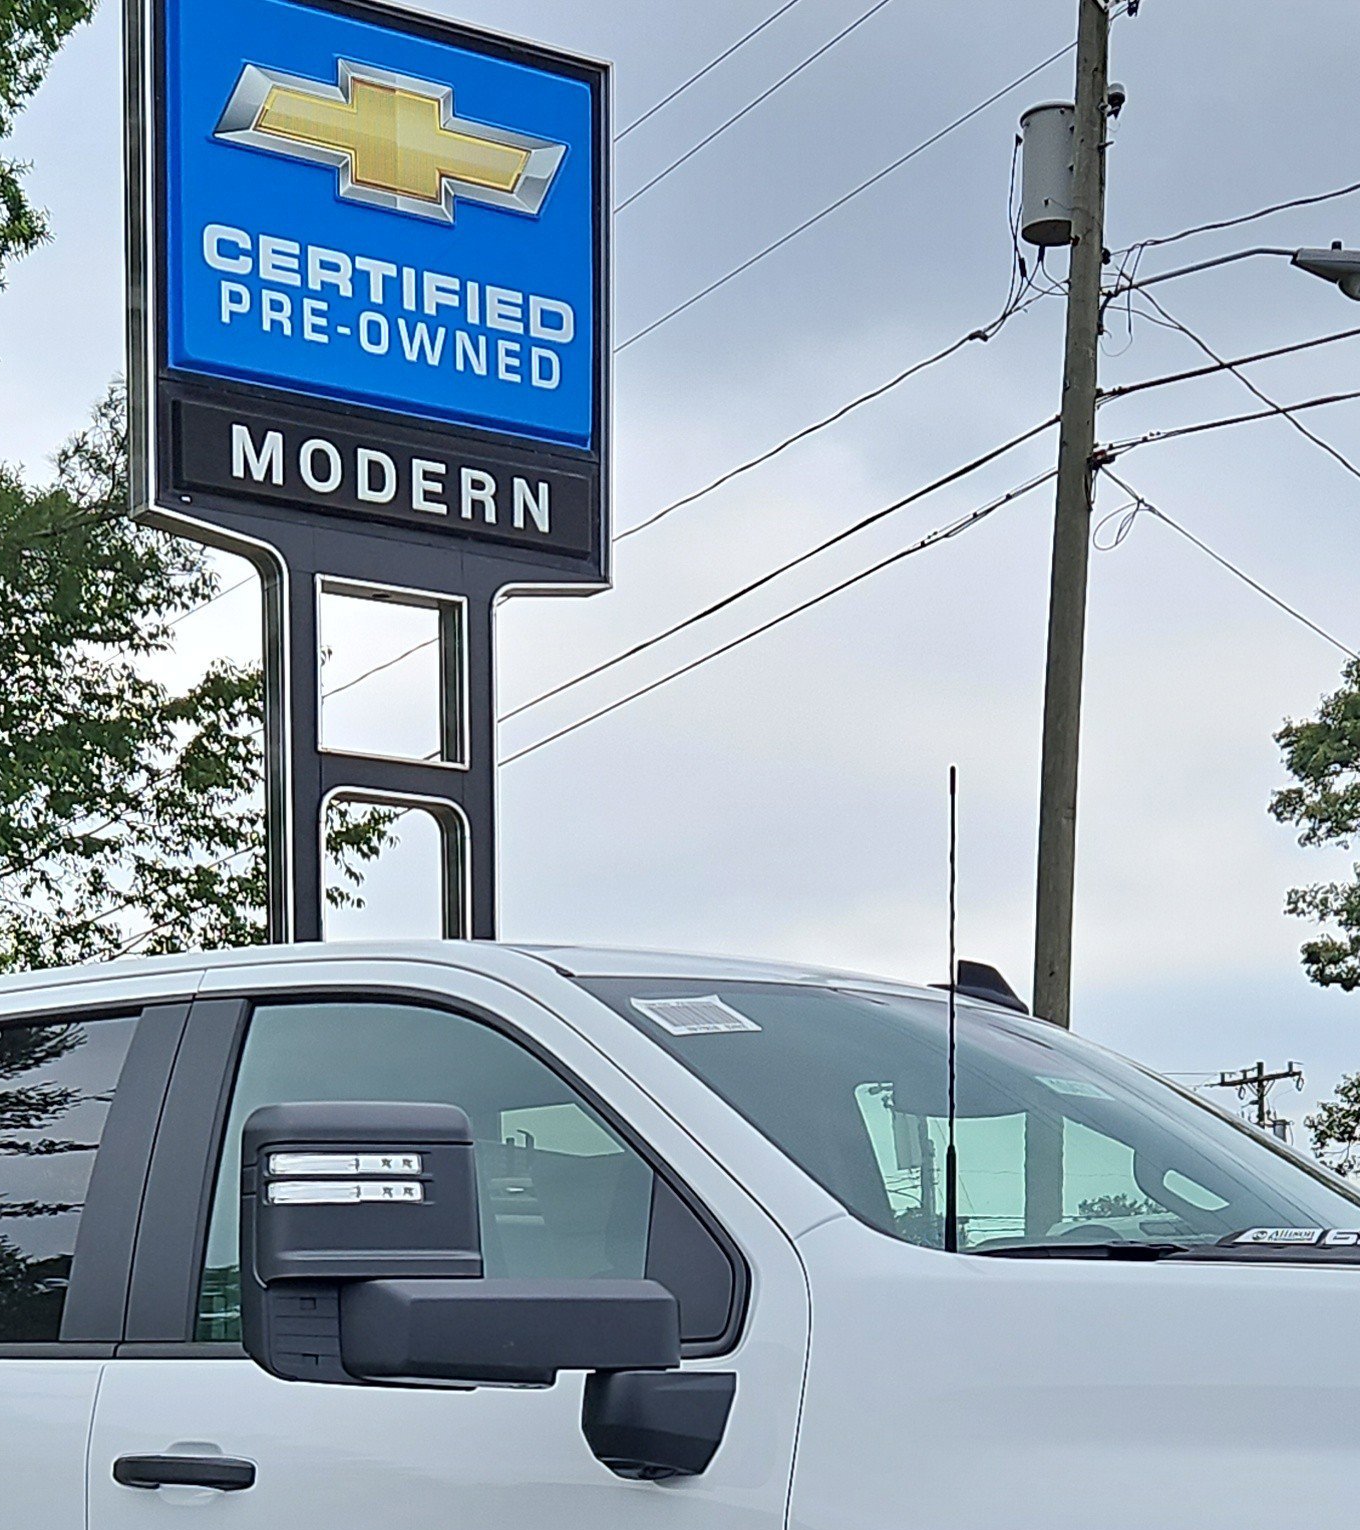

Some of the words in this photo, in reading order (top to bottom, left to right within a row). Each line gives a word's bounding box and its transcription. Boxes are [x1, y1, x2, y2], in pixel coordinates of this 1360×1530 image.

[202, 223, 575, 343] CERTIFIED
[220, 280, 561, 390] PRE-OWNED
[231, 424, 551, 533] MODERN
